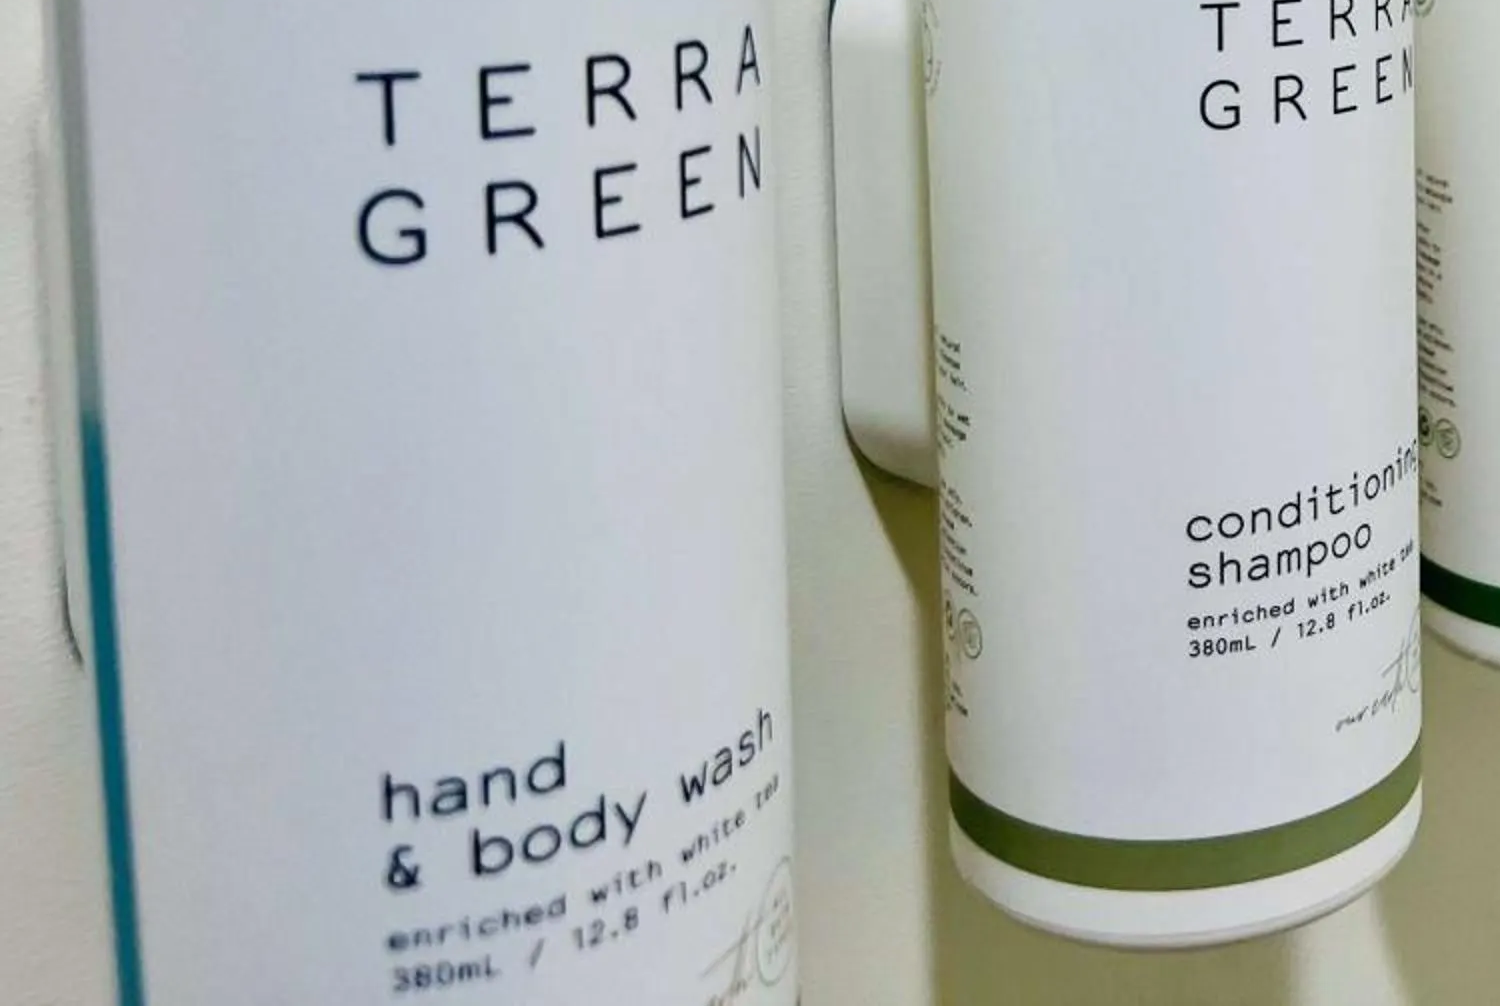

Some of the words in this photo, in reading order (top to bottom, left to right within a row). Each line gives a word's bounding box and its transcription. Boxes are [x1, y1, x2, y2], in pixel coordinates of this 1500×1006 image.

[354, 24, 762, 147] TERRA
[1199, 46, 1413, 131] GREEN
[356, 125, 762, 267] GREEN
[1186, 597, 1296, 631] enriched
[1307, 580, 1350, 610] with
[1358, 557, 1396, 590] white
[1187, 522, 1373, 589] shampoo
[1188, 636, 1257, 659] 380mL
[1270, 626, 1282, 649] /
[1296, 612, 1336, 640] 12.8
[1347, 590, 1392, 622] fl.oz.
[381, 739, 568, 824] hand
[385, 843, 422, 892] &
[470, 791, 648, 878] body
[679, 707, 774, 805] wash
[386, 894, 569, 953] enriched
[589, 859, 663, 905] with
[681, 808, 747, 864] white
[391, 952, 502, 994] 380mL
[527, 937, 546, 970] /
[570, 906, 640, 952] 12.8
[662, 861, 738, 916] fl.oz.
